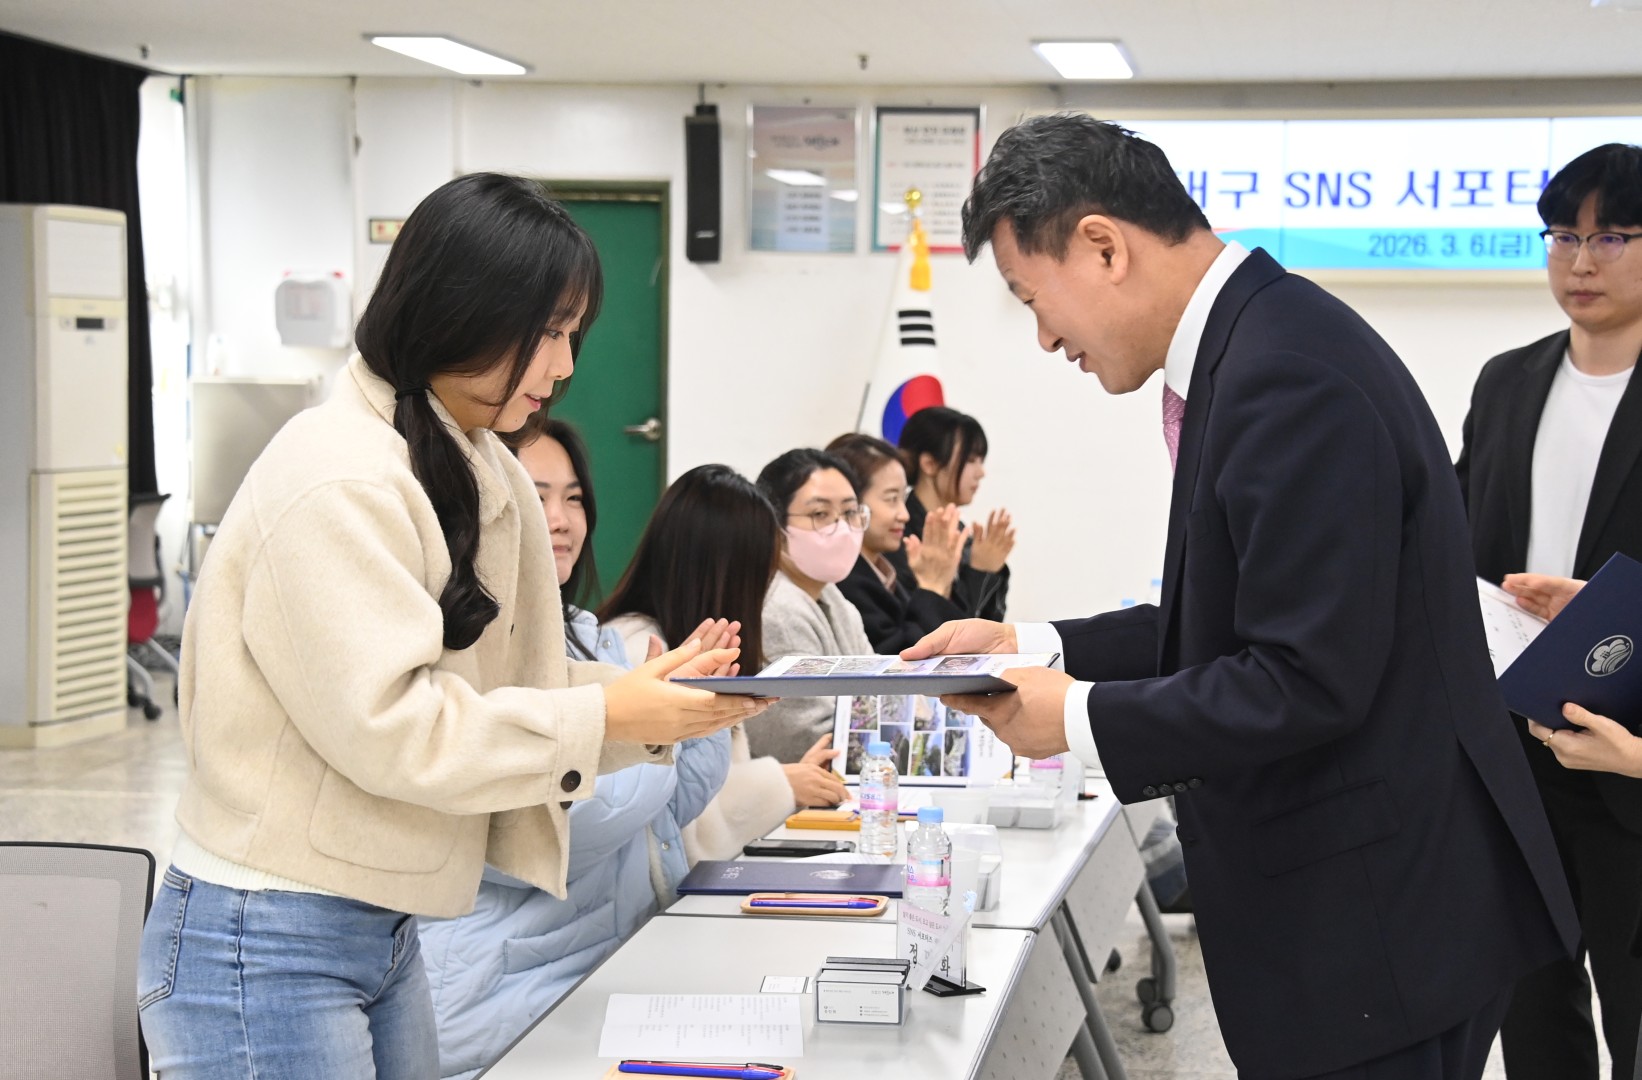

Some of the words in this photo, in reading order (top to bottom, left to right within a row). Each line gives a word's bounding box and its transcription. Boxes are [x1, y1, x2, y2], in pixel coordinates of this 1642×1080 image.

[1284, 170, 1373, 208] SNS
[1368, 234, 1432, 257] 2026.
[1441, 233, 1460, 257] 3.
